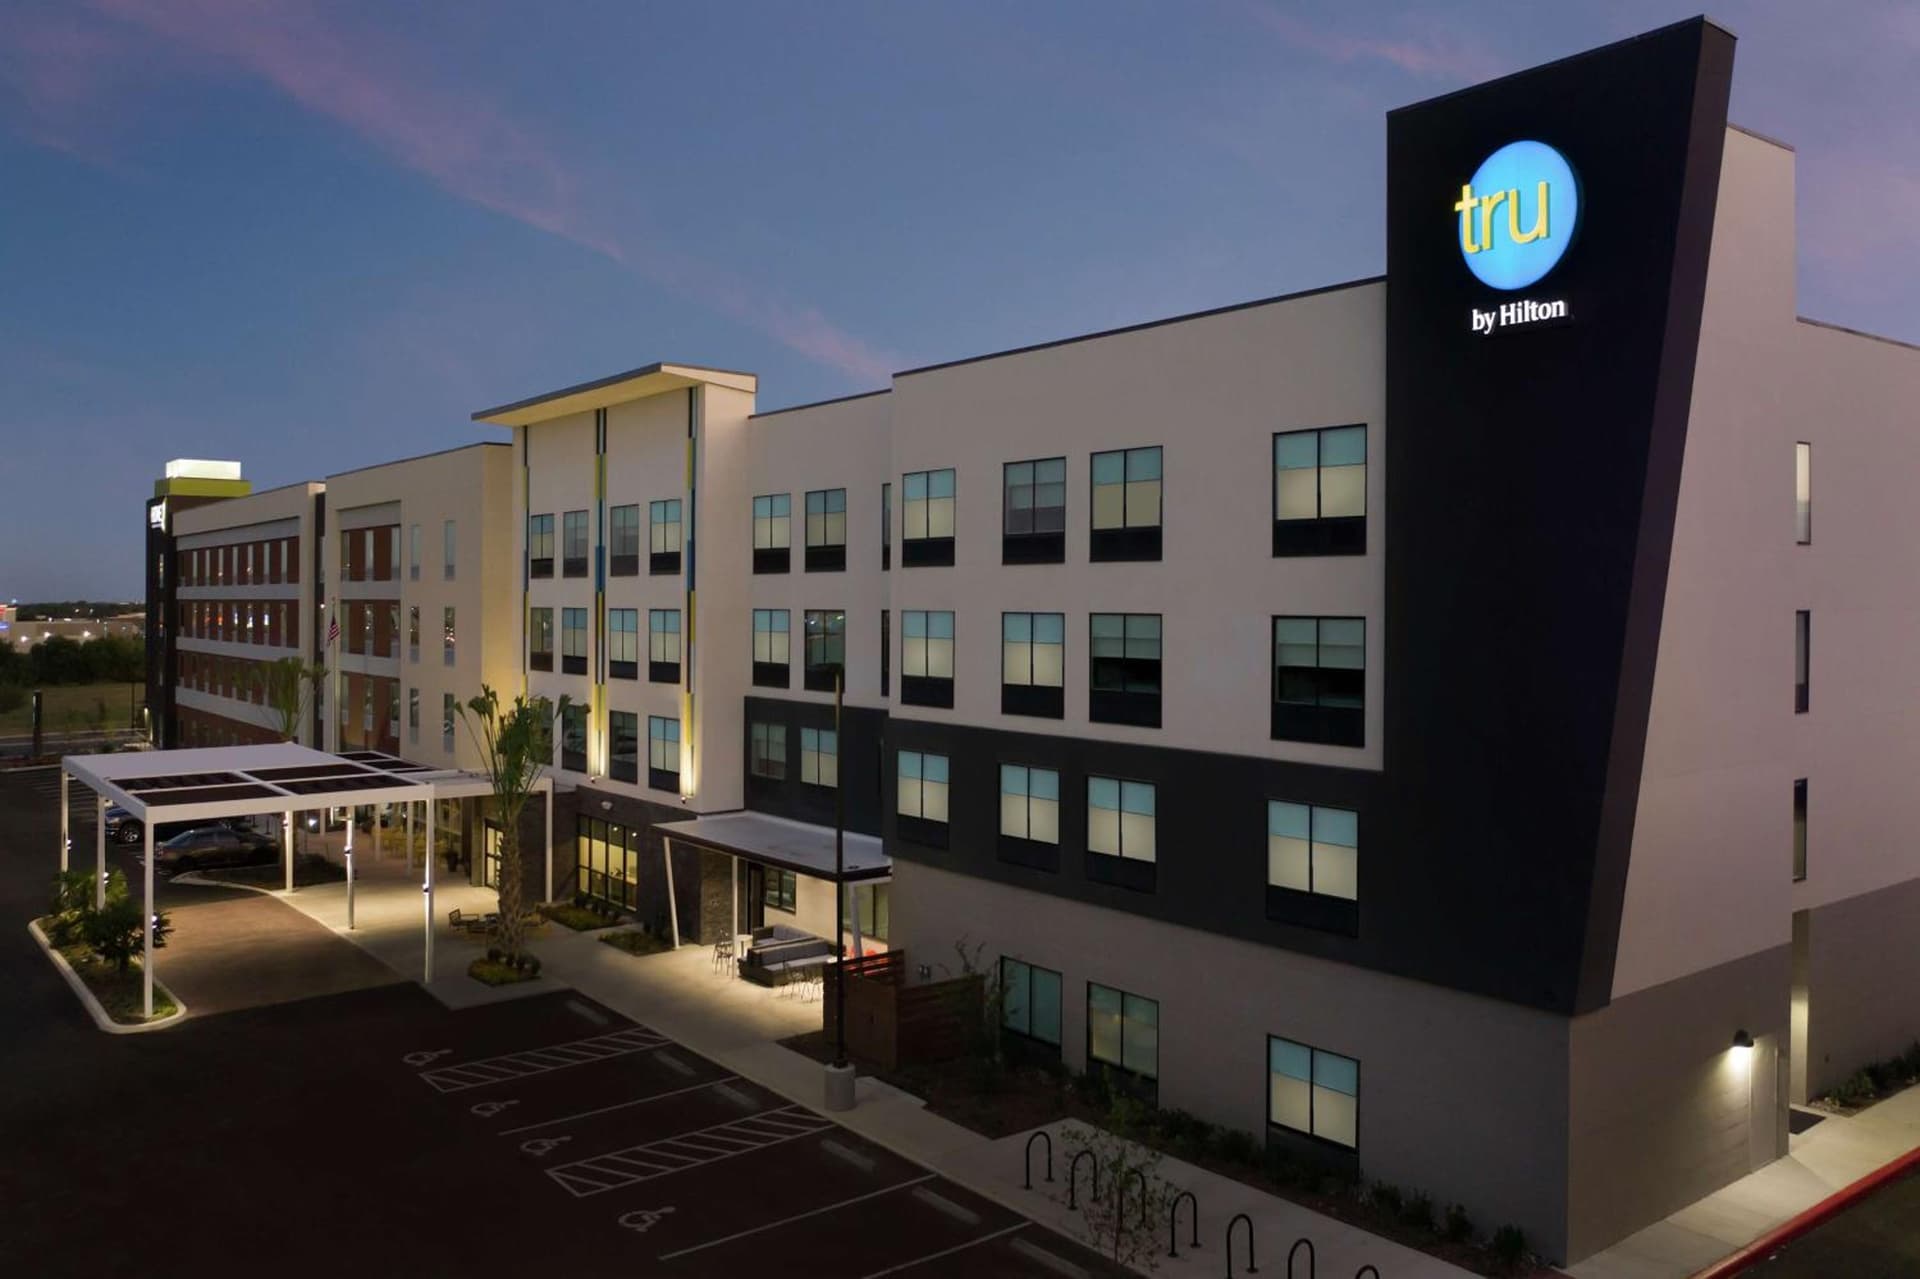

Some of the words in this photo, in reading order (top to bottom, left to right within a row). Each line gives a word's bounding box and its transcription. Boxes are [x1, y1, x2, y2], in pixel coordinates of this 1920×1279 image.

[1454, 181, 1549, 254] tru
[1472, 308, 1496, 334] by
[1500, 300, 1566, 326] Hilton
